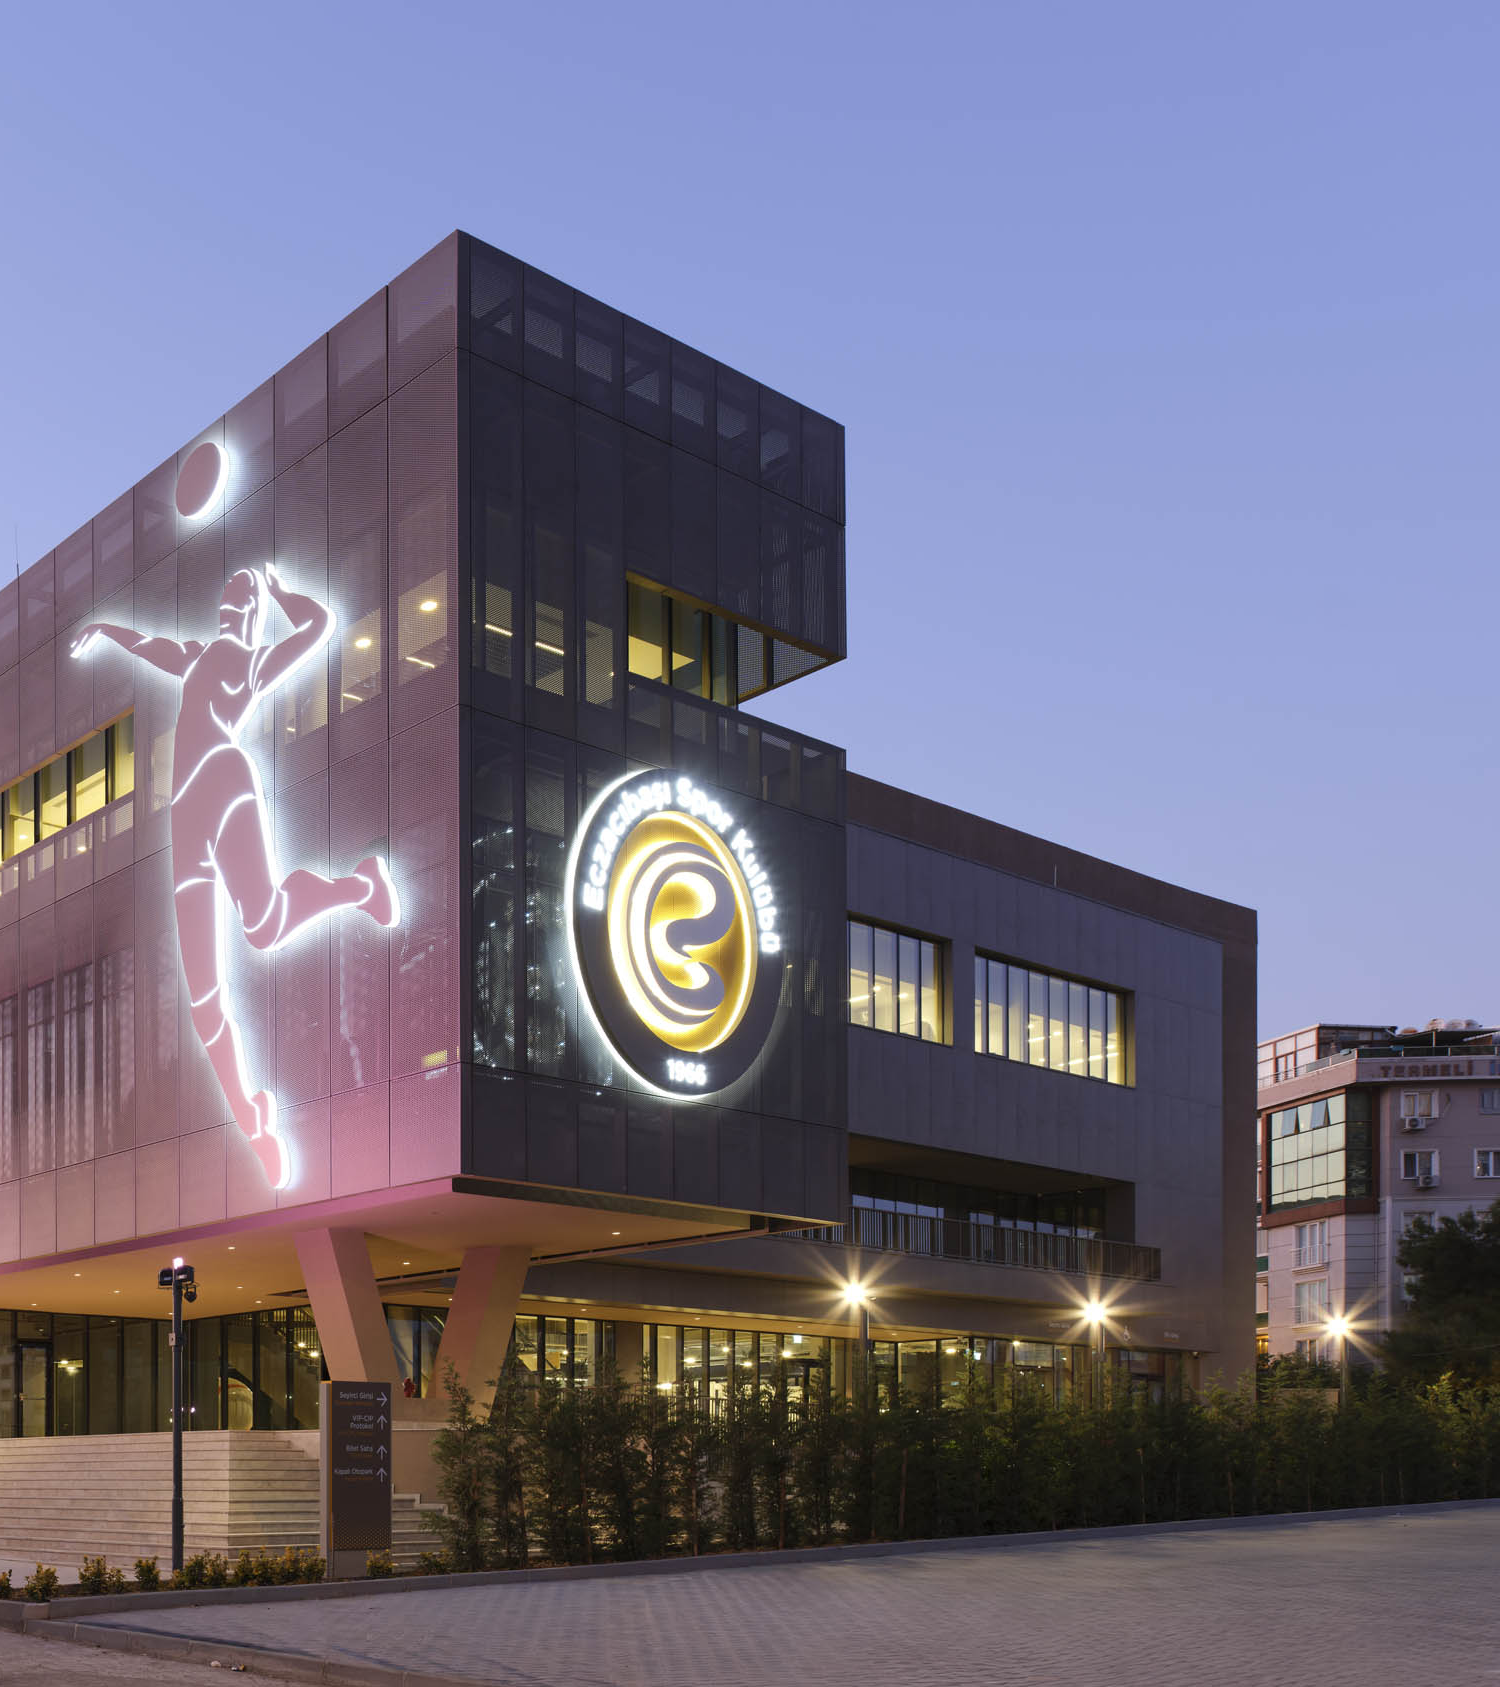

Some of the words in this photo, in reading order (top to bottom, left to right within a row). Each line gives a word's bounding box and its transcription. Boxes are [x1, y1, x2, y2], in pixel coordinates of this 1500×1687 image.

[583, 781, 672, 911] Eczacıbaşı
[675, 777, 734, 833] Spor
[666, 1058, 707, 1087] 1966
